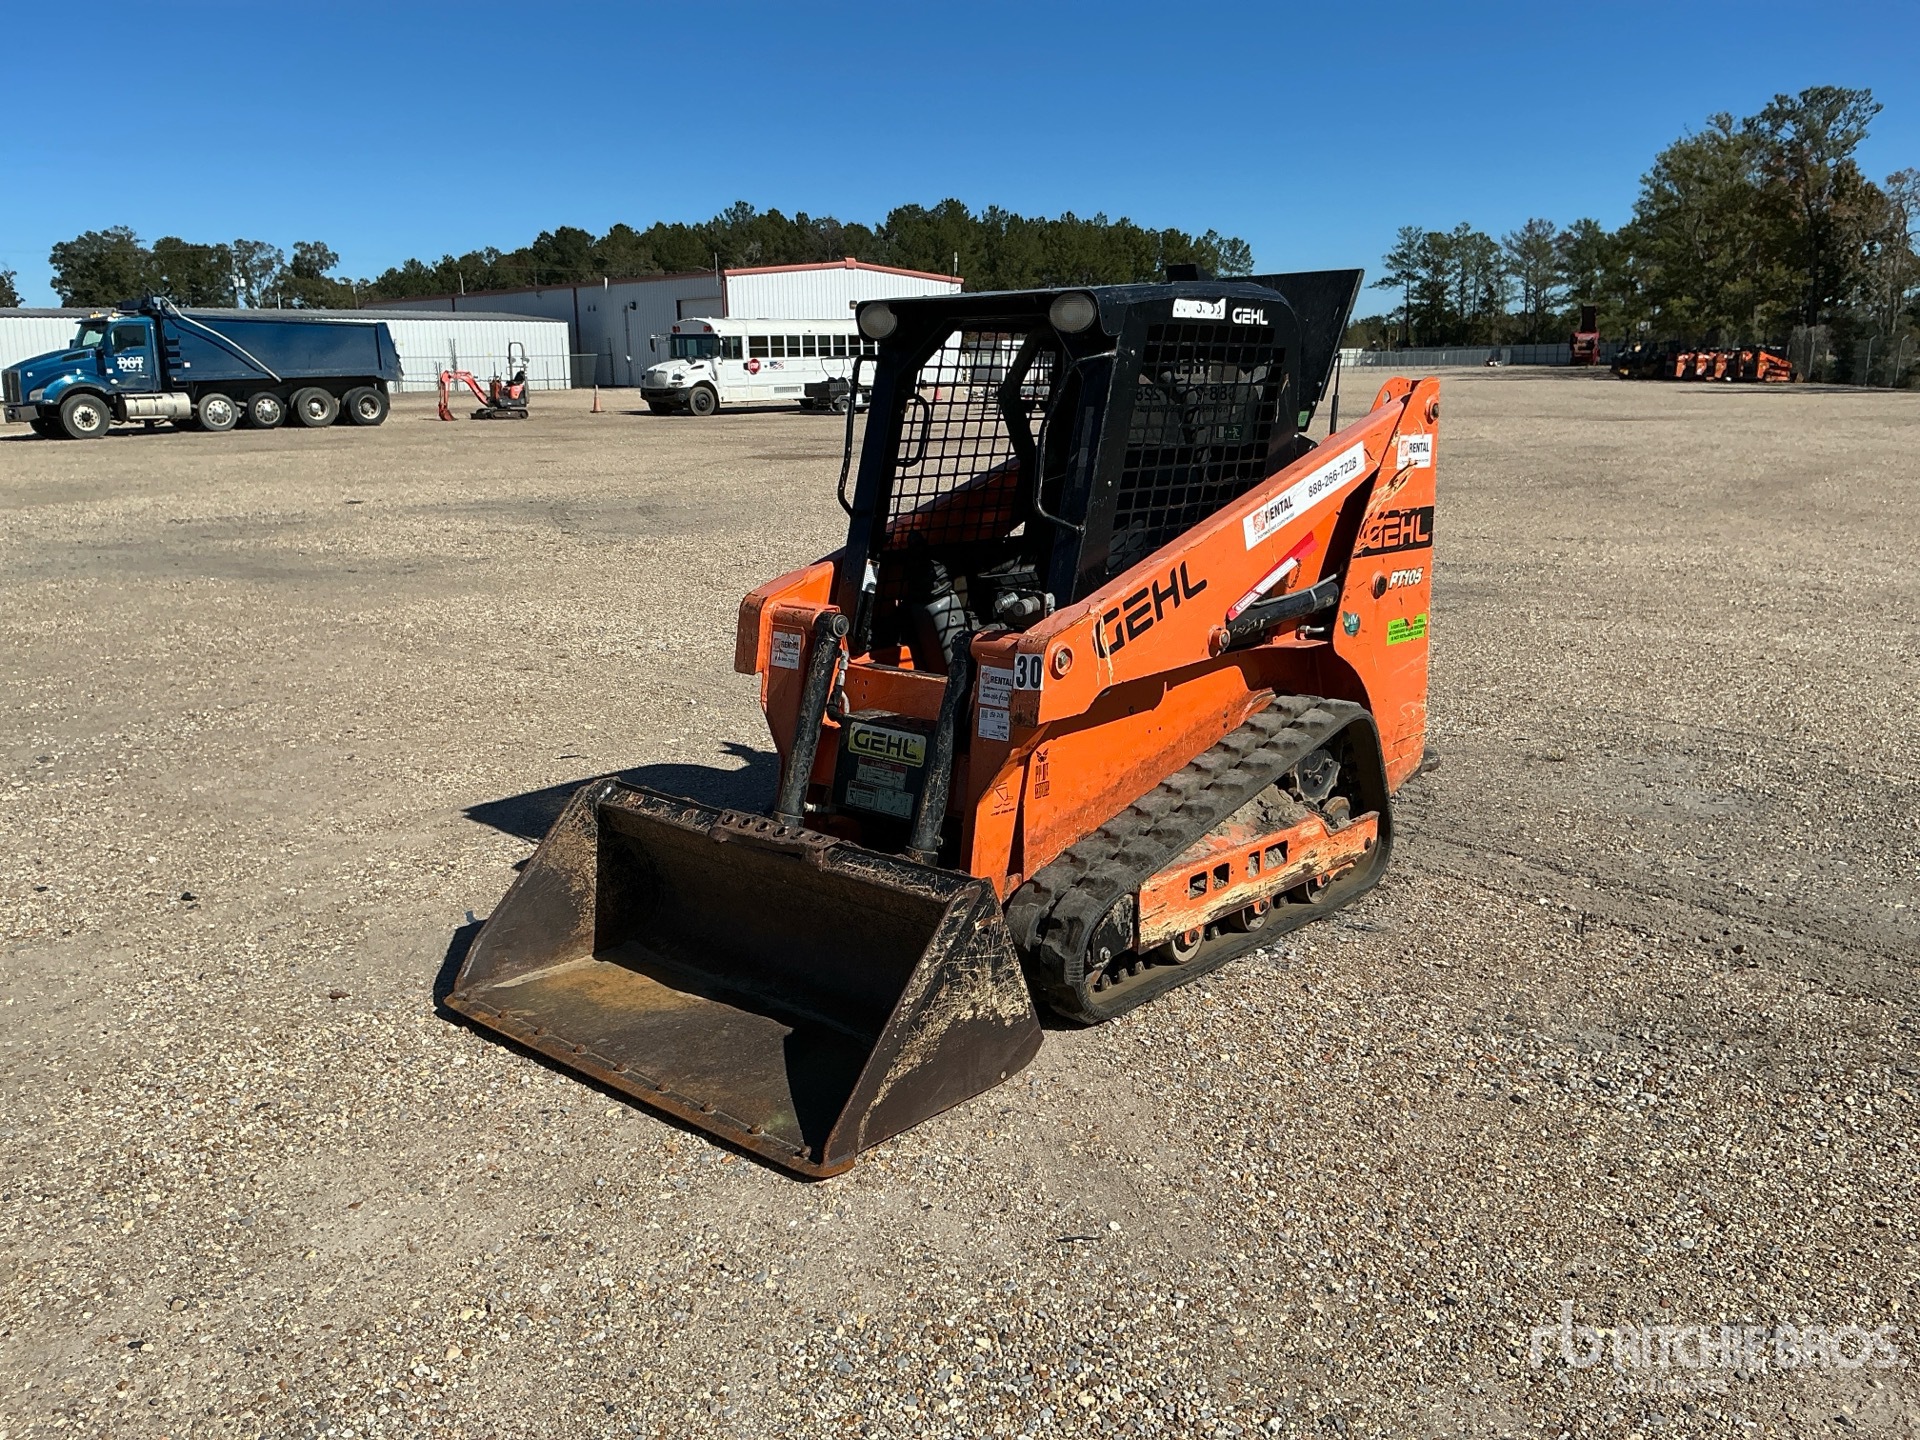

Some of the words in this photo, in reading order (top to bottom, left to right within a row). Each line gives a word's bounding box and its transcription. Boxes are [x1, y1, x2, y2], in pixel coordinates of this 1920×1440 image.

[1232, 308, 1269, 325] GEHL
[1409, 442, 1429, 453] RENTAL
[1308, 456, 1357, 498] 888-266-7228
[1364, 513, 1429, 549] GEHL
[1388, 568, 1423, 590] PT105
[1092, 560, 1208, 659] GEHL
[990, 675, 1013, 687] RENTAL
[1015, 655, 1042, 689] 30
[853, 729, 917, 760] GEHL
